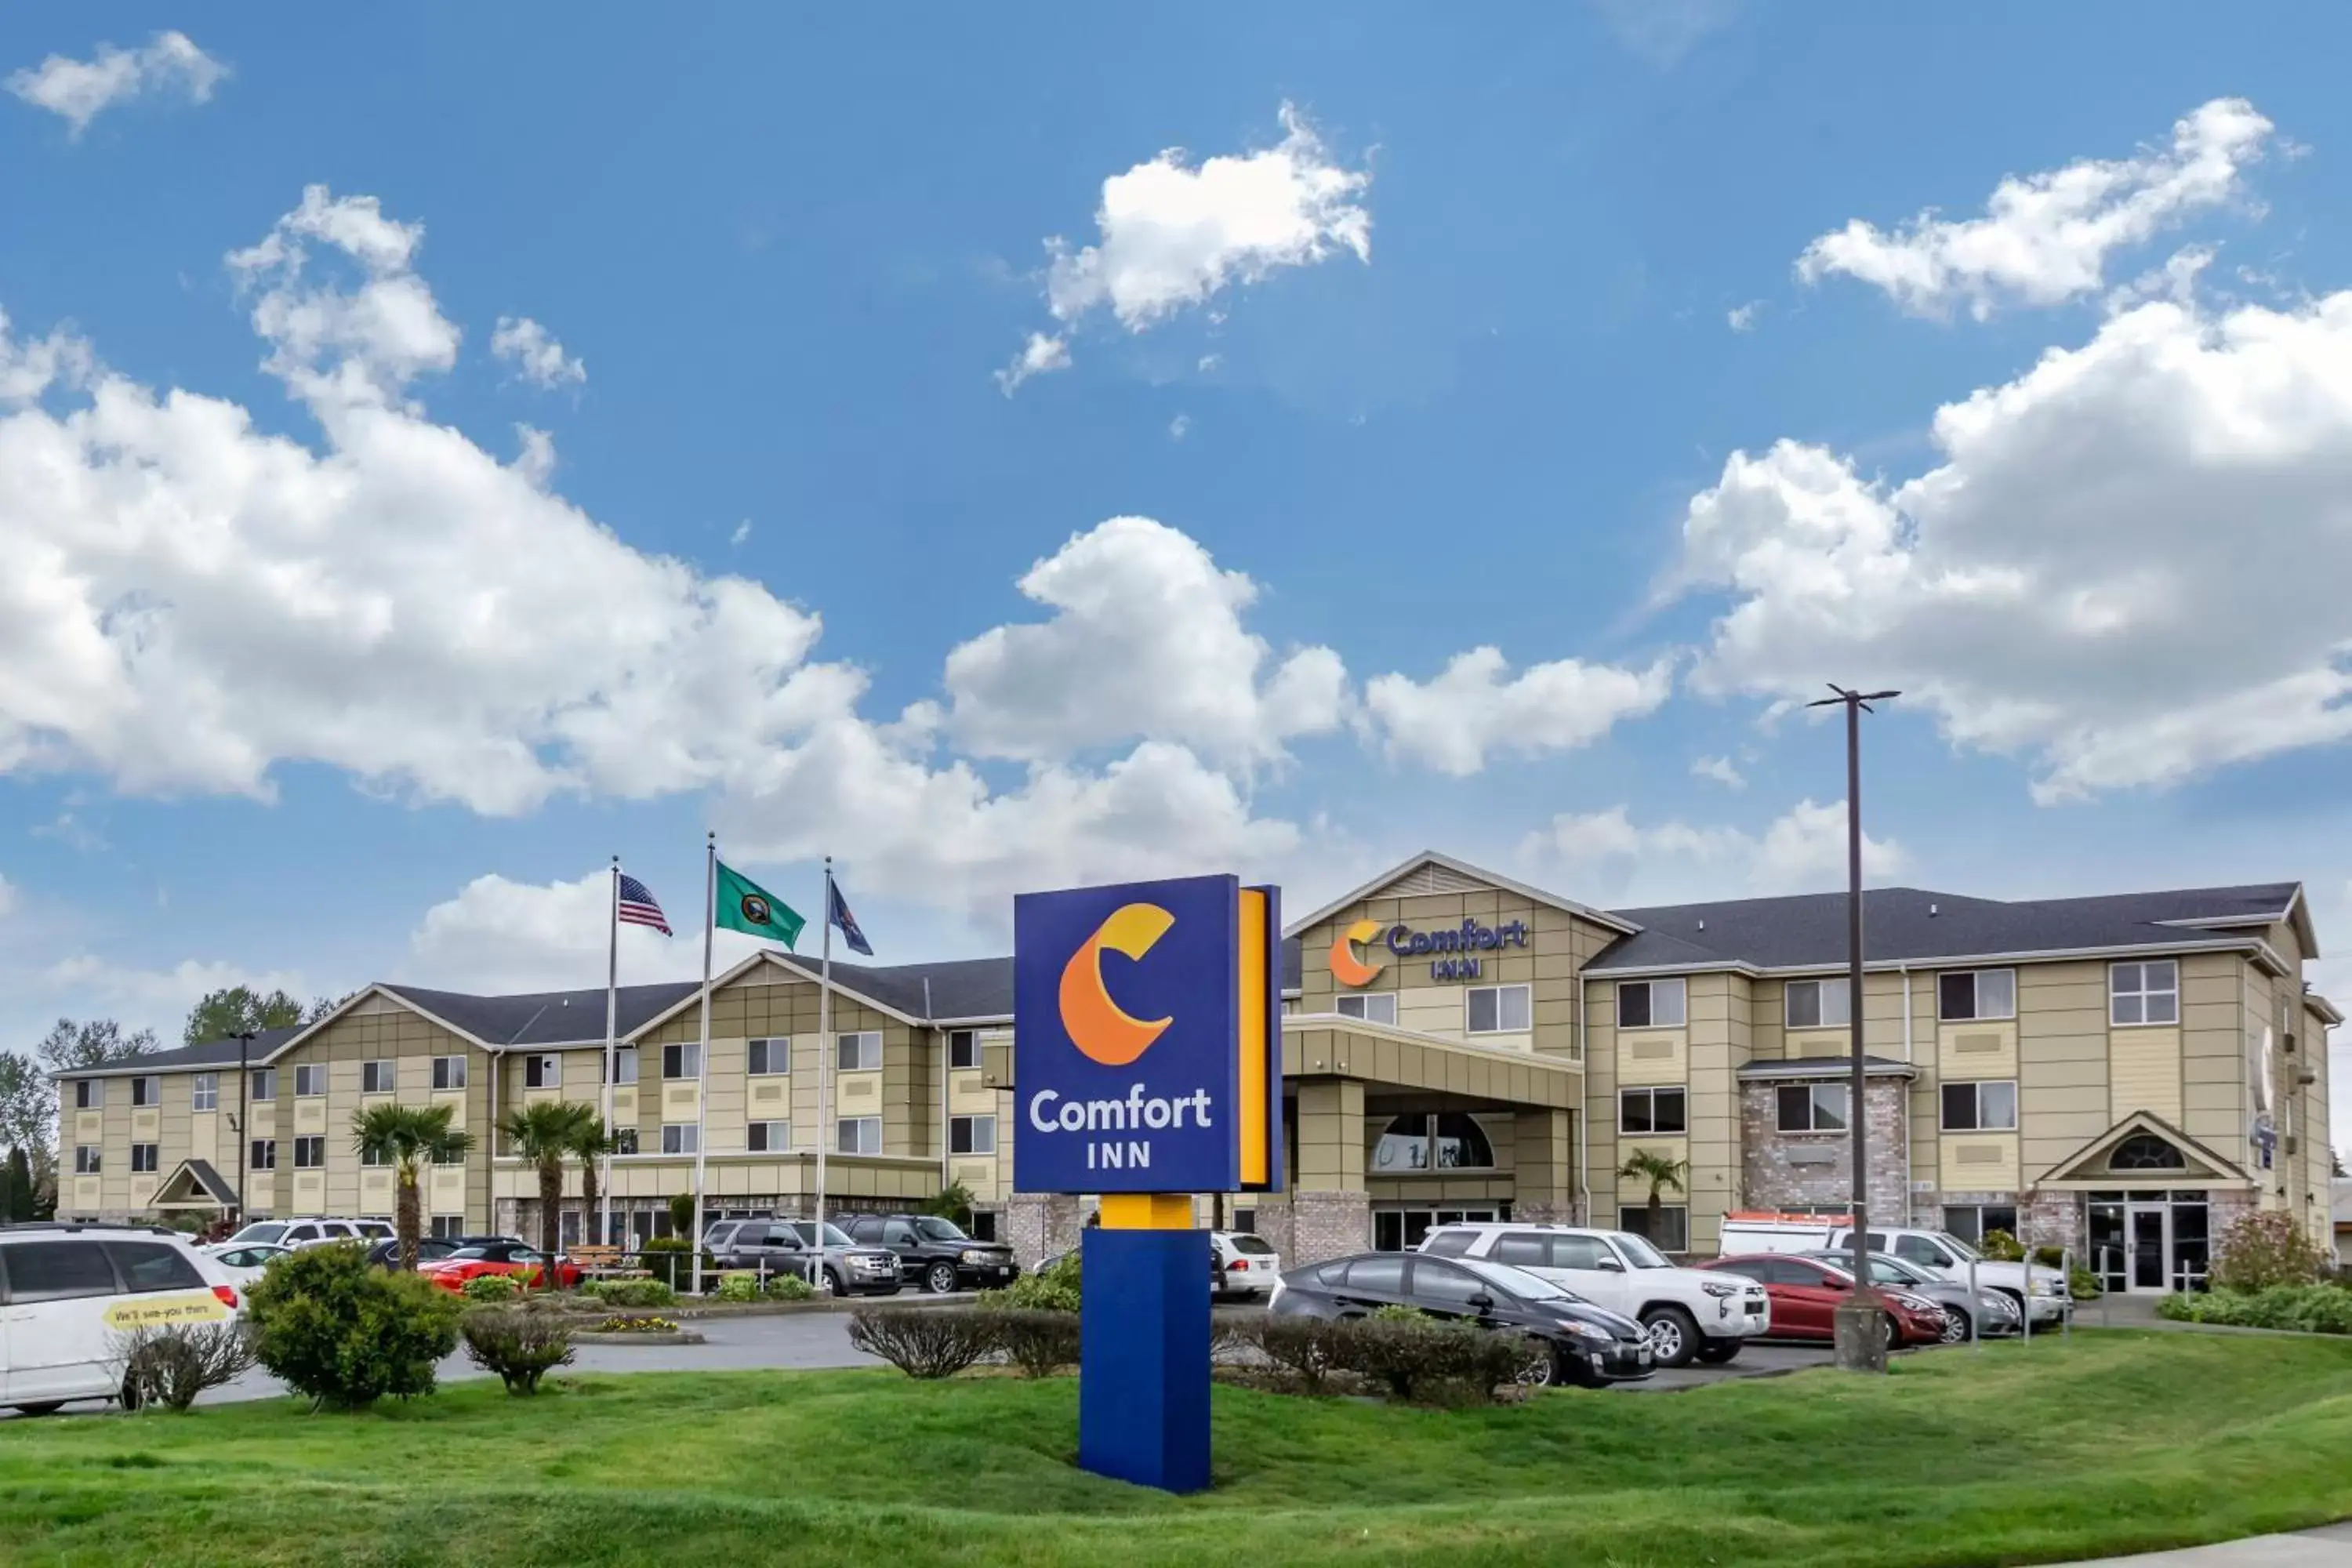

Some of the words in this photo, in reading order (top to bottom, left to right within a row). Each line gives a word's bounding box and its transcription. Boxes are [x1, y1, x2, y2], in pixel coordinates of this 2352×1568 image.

[1386, 917, 1528, 956] Comfort
[1432, 958, 1481, 980] INN
[1029, 1083, 1212, 1133] Comfort
[1087, 1141, 1150, 1169] INN
